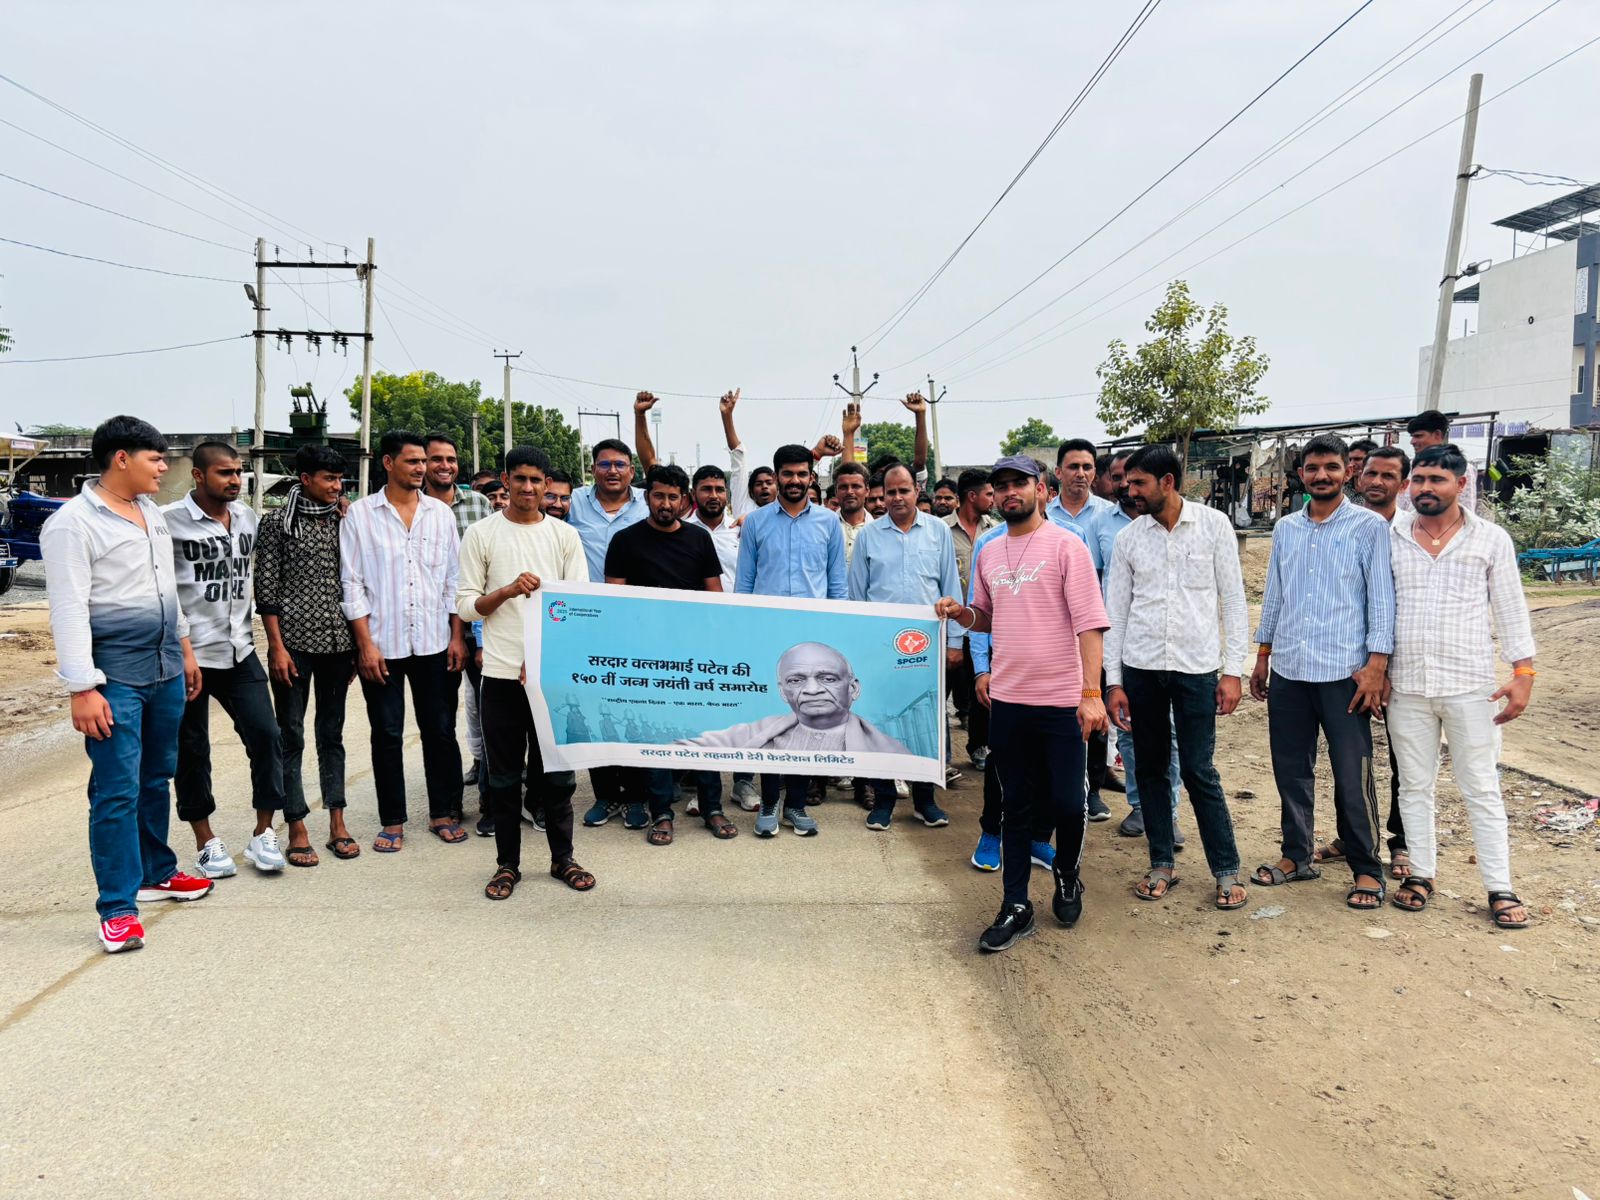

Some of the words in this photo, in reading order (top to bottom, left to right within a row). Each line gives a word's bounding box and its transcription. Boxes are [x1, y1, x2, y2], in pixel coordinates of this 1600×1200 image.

[181, 532, 234, 562] OUT
[588, 655, 628, 669] सरदार
[631, 658, 694, 674] वल्लभभाई
[697, 659, 728, 676] पटेल
[732, 662, 751, 677] की
[896, 656, 928, 665] SPCDF
[571, 672, 598, 684] १५०
[601, 671, 616, 686] वीं
[652, 675, 690, 691] जयंती
[694, 678, 714, 692] वर्ष
[718, 681, 768, 693] समारोह
[639, 748, 672, 757] सरदार
[675, 748, 699, 759] पटेल
[703, 751, 744, 761] सहकारी
[746, 751, 764, 761] डेरी
[767, 752, 811, 763] फेडरेशन
[814, 753, 855, 764] लिमिटेड
